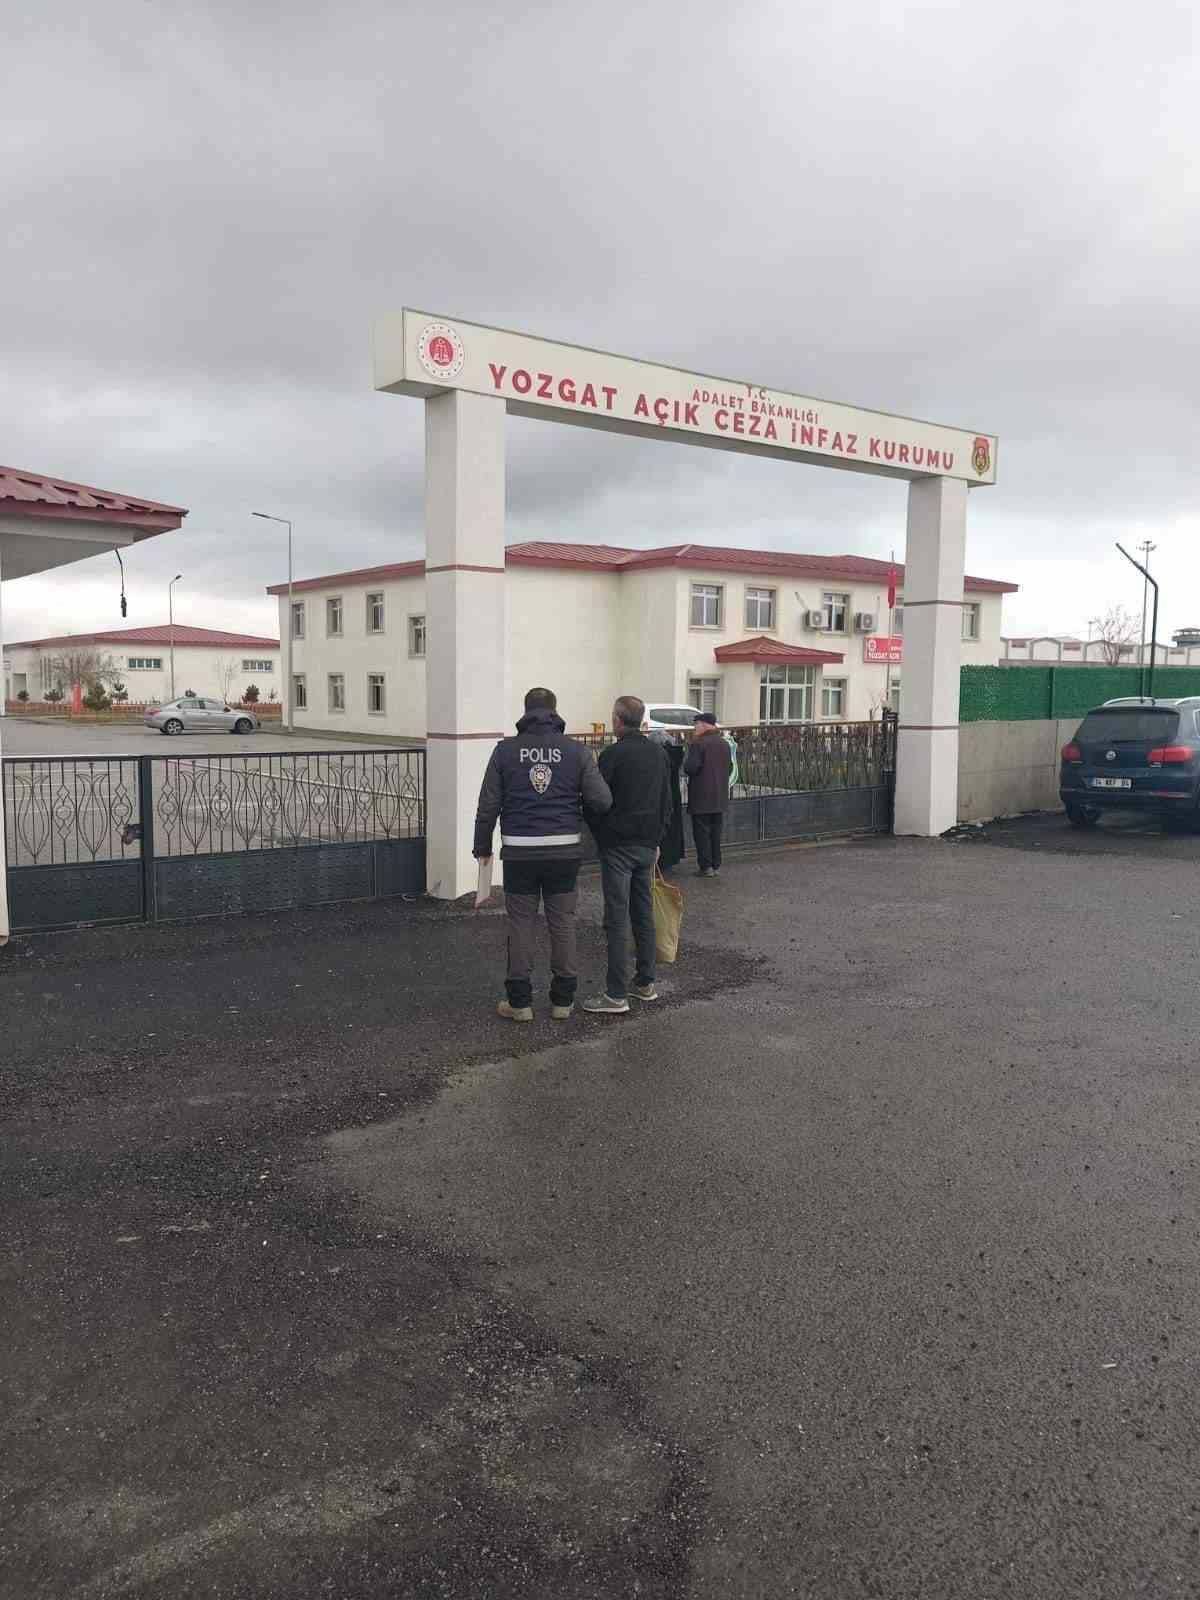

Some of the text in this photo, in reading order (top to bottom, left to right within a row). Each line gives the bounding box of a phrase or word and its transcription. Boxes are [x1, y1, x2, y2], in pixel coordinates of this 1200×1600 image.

[746, 384, 771, 401] T.C.
[488, 363, 954, 470] YOZGAT AÇIK CEZA İNFAZ KURUMU
[692, 389, 818, 425] ADALET BAKANLIĞI
[520, 748, 562, 763] POLIS
